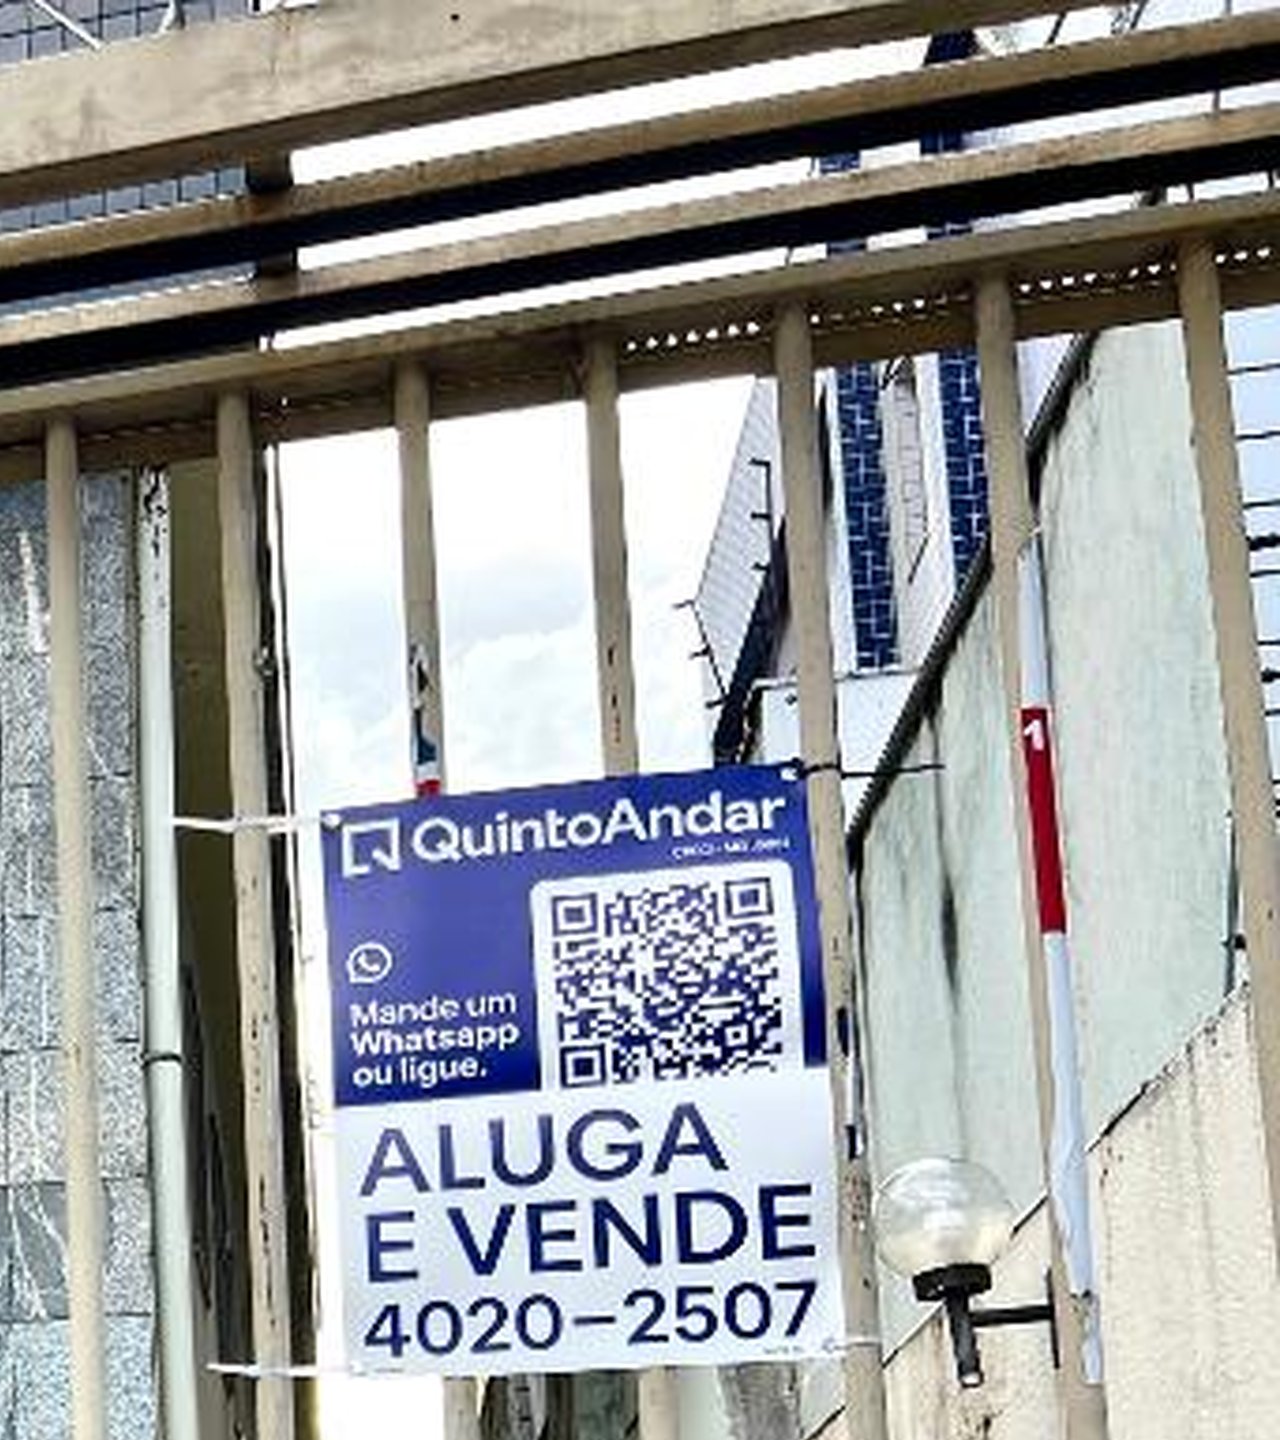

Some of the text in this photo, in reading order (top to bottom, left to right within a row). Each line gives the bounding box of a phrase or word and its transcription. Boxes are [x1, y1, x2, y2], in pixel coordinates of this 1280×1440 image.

[412, 790, 787, 863] QuintoAndar
[349, 992, 517, 1028] Mande um
[349, 1023, 521, 1057] Whatsapp
[352, 1056, 488, 1089] ou ligue.
[359, 1102, 729, 1197] ALUGA
[365, 1183, 817, 1284] E VENDE
[363, 1280, 818, 1358] 4020-2507
